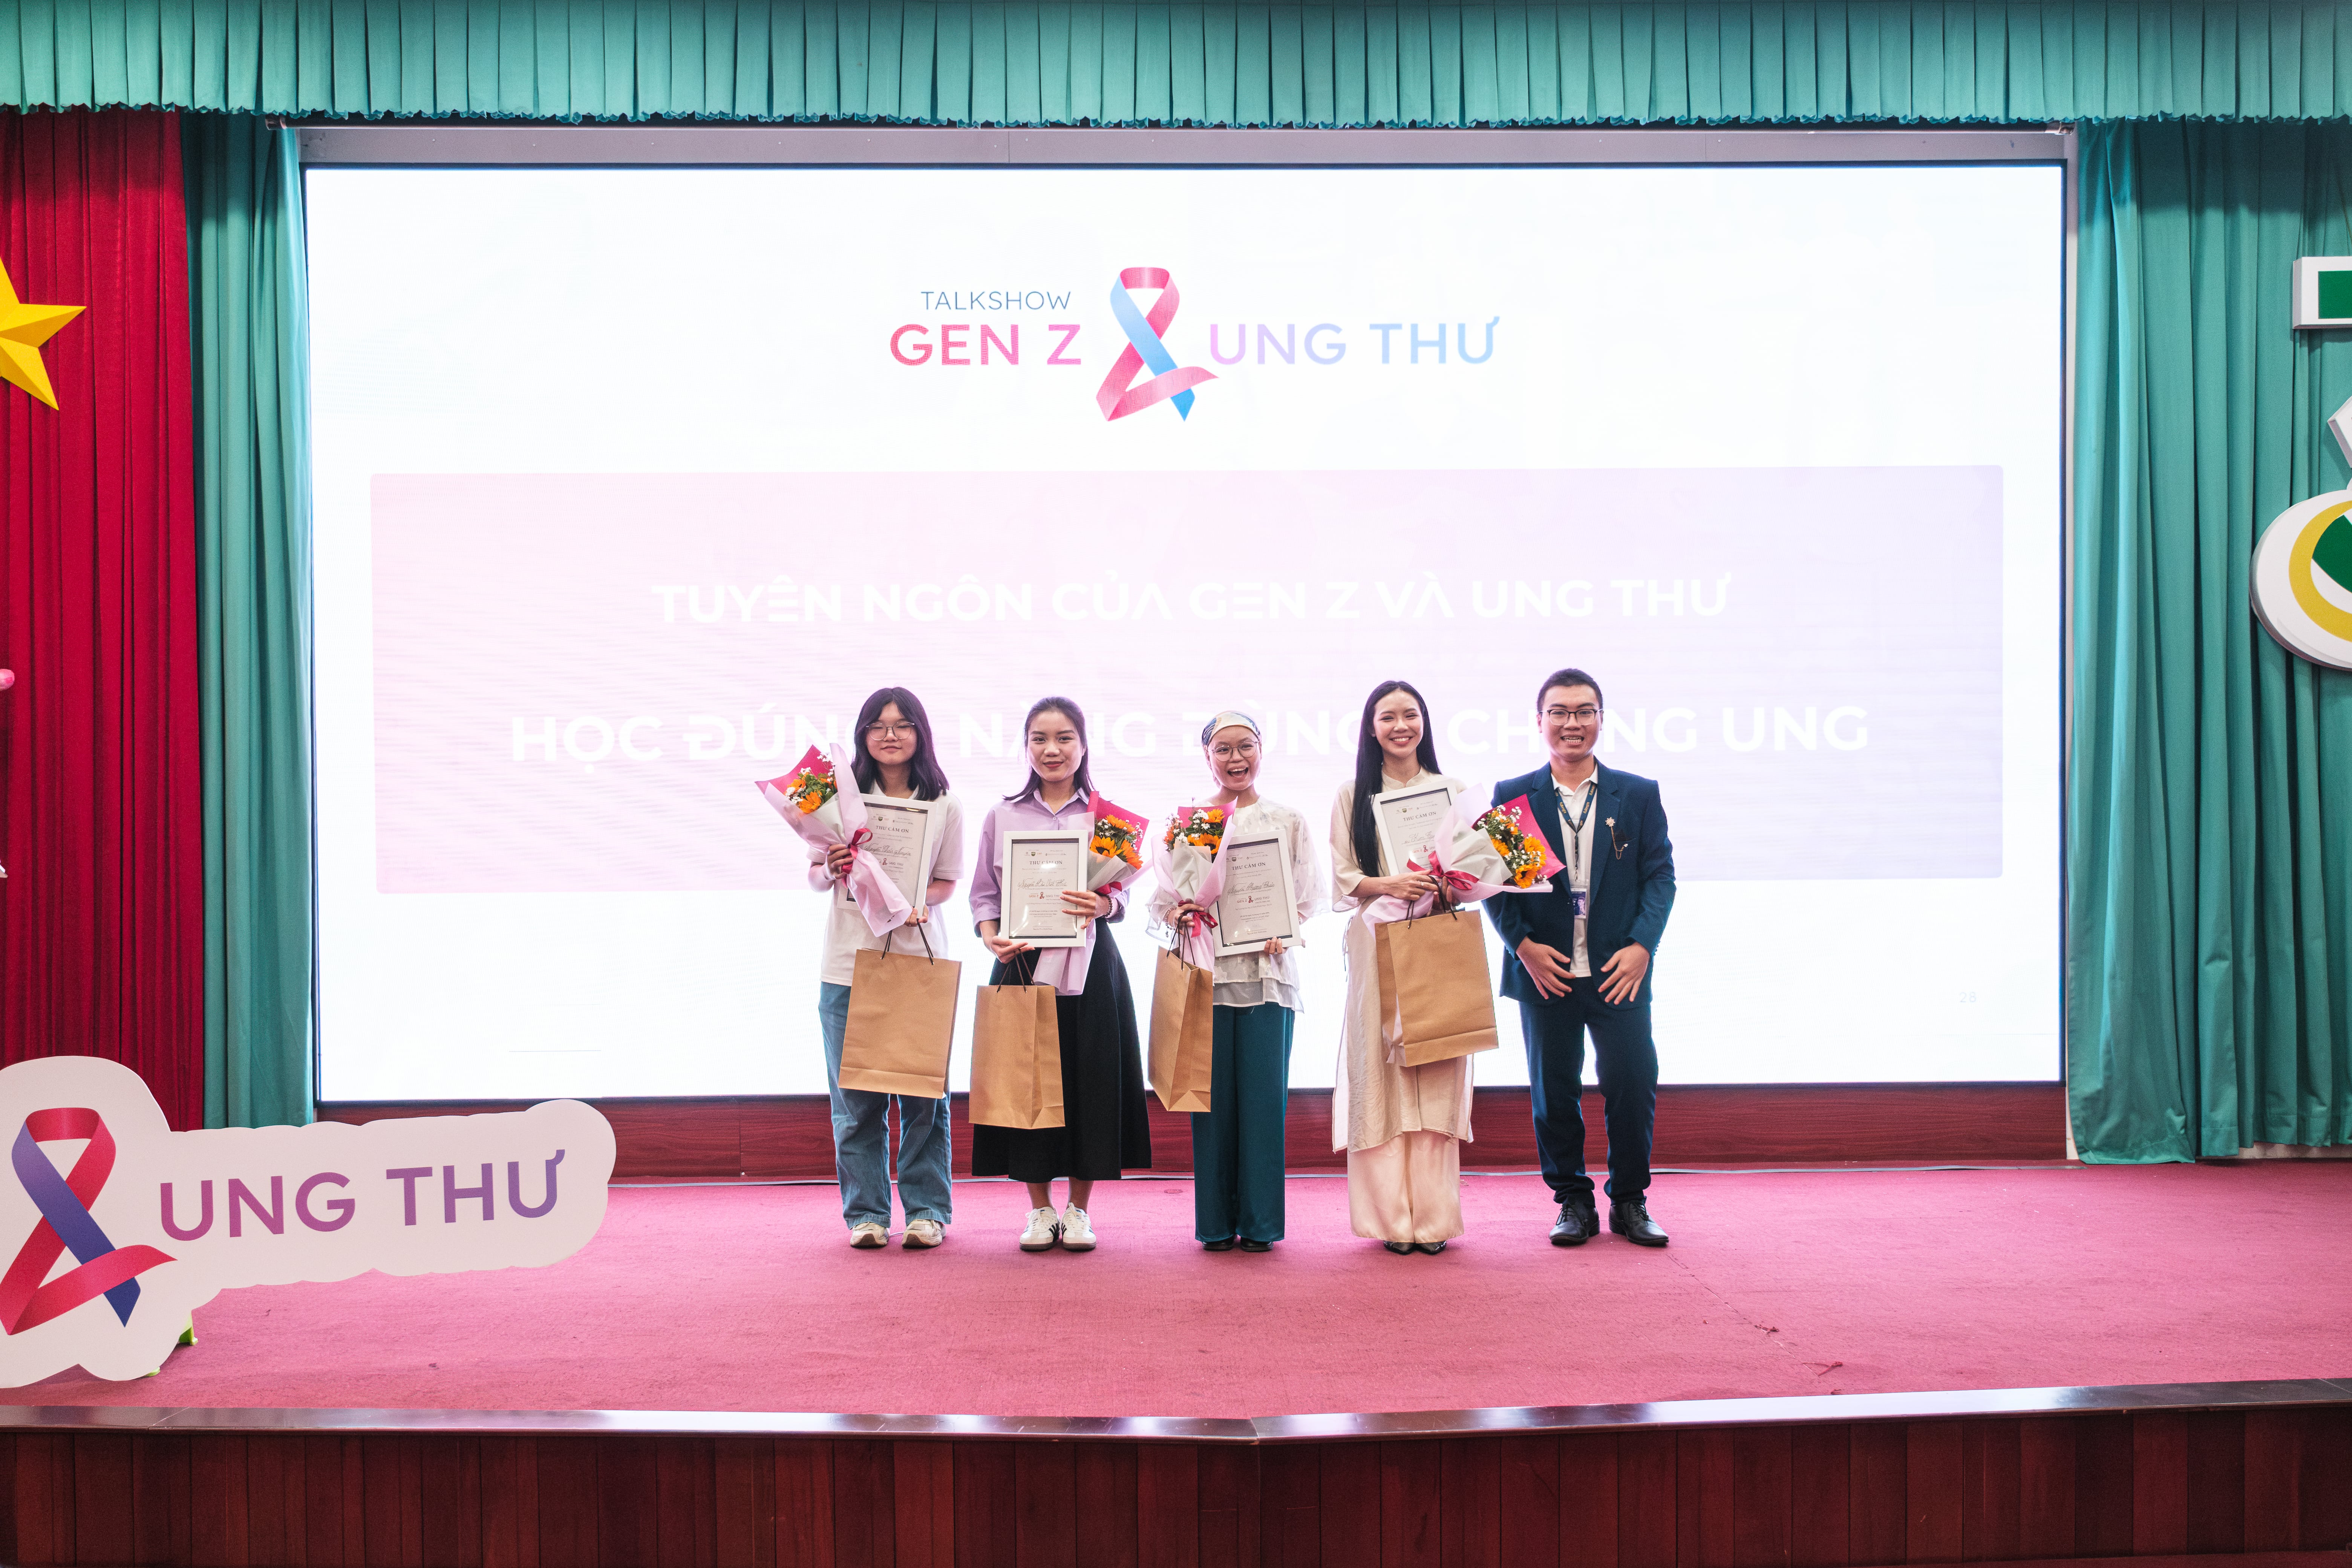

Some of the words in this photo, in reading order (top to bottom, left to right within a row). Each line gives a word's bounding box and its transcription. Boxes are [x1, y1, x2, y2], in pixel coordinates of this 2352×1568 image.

[920, 290, 1071, 310] TALKSHOW
[890, 323, 1019, 366] GEN
[1046, 324, 1081, 365] Z
[1210, 323, 1346, 364] UNG
[1369, 316, 1500, 364] THƯ
[651, 575, 842, 623] TUYÊN
[862, 573, 1032, 622] NGÔN
[1052, 570, 1173, 621] CỦA
[1188, 580, 1306, 620] GEN
[1325, 580, 1360, 620] Z
[1375, 571, 1455, 619] VÀ
[1472, 579, 1594, 619] UNG
[1610, 571, 1732, 617] THƯ
[512, 715, 663, 774] HỌC
[683, 702, 855, 760] ĐÚN
[959, 700, 1156, 758] NNG
[1447, 707, 1697, 754] CHNG
[1722, 705, 1868, 752] UNG
[1959, 991, 1977, 1003] 28
[159, 1171, 355, 1242] UNG
[385, 1148, 565, 1227] THƯ
